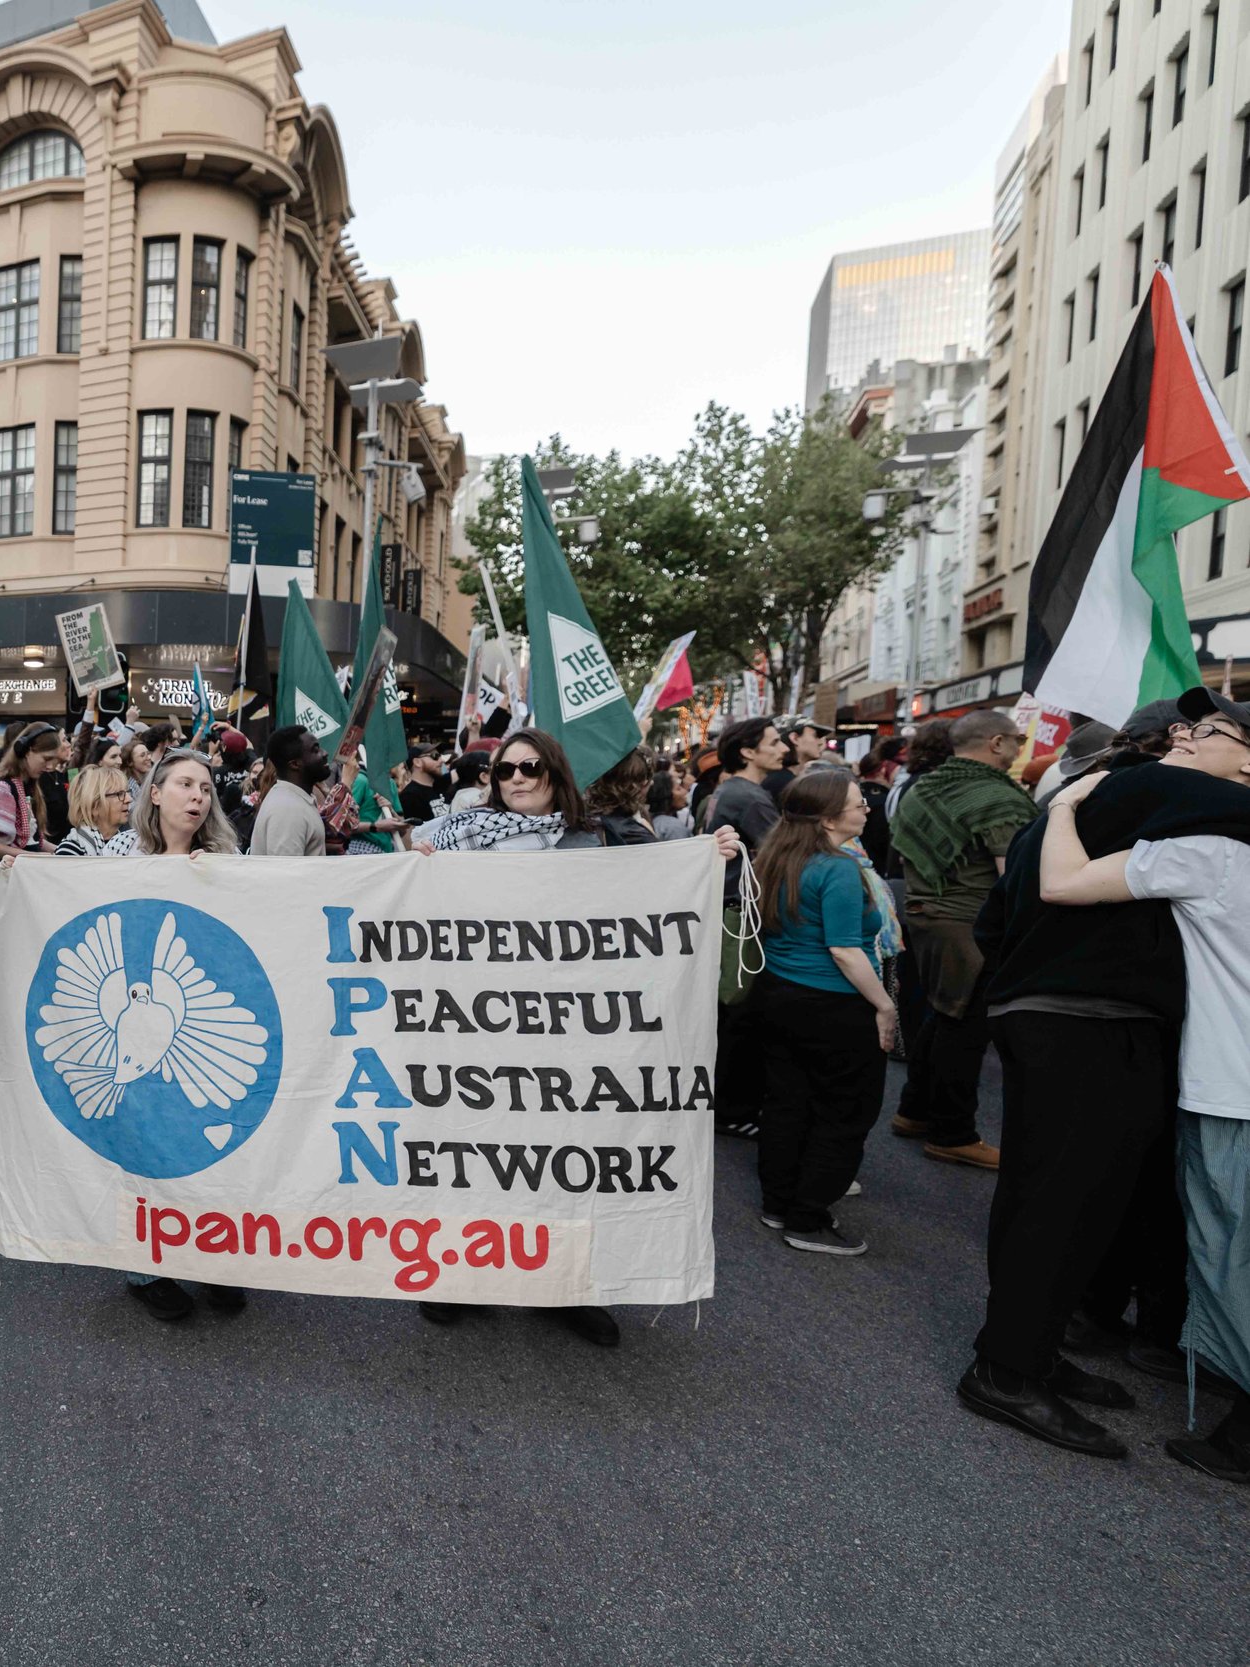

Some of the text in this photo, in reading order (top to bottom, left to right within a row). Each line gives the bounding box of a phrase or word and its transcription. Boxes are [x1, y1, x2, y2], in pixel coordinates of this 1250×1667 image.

[233, 494, 268, 506] For Lease
[61, 611, 84, 624] FROM
[63, 621, 78, 631] THE
[65, 626, 88, 639] RIVER
[67, 633, 92, 646] TO THE
[69, 644, 84, 653] SEA
[561, 643, 606, 676] THE
[322, 905, 701, 964] INDEPENDENT
[327, 976, 663, 1036] PEACEFUL
[335, 1047, 715, 1112] AUSTRALIA
[334, 1121, 677, 1193] NETWORK
[135, 1196, 551, 1292] ipan.org.au
